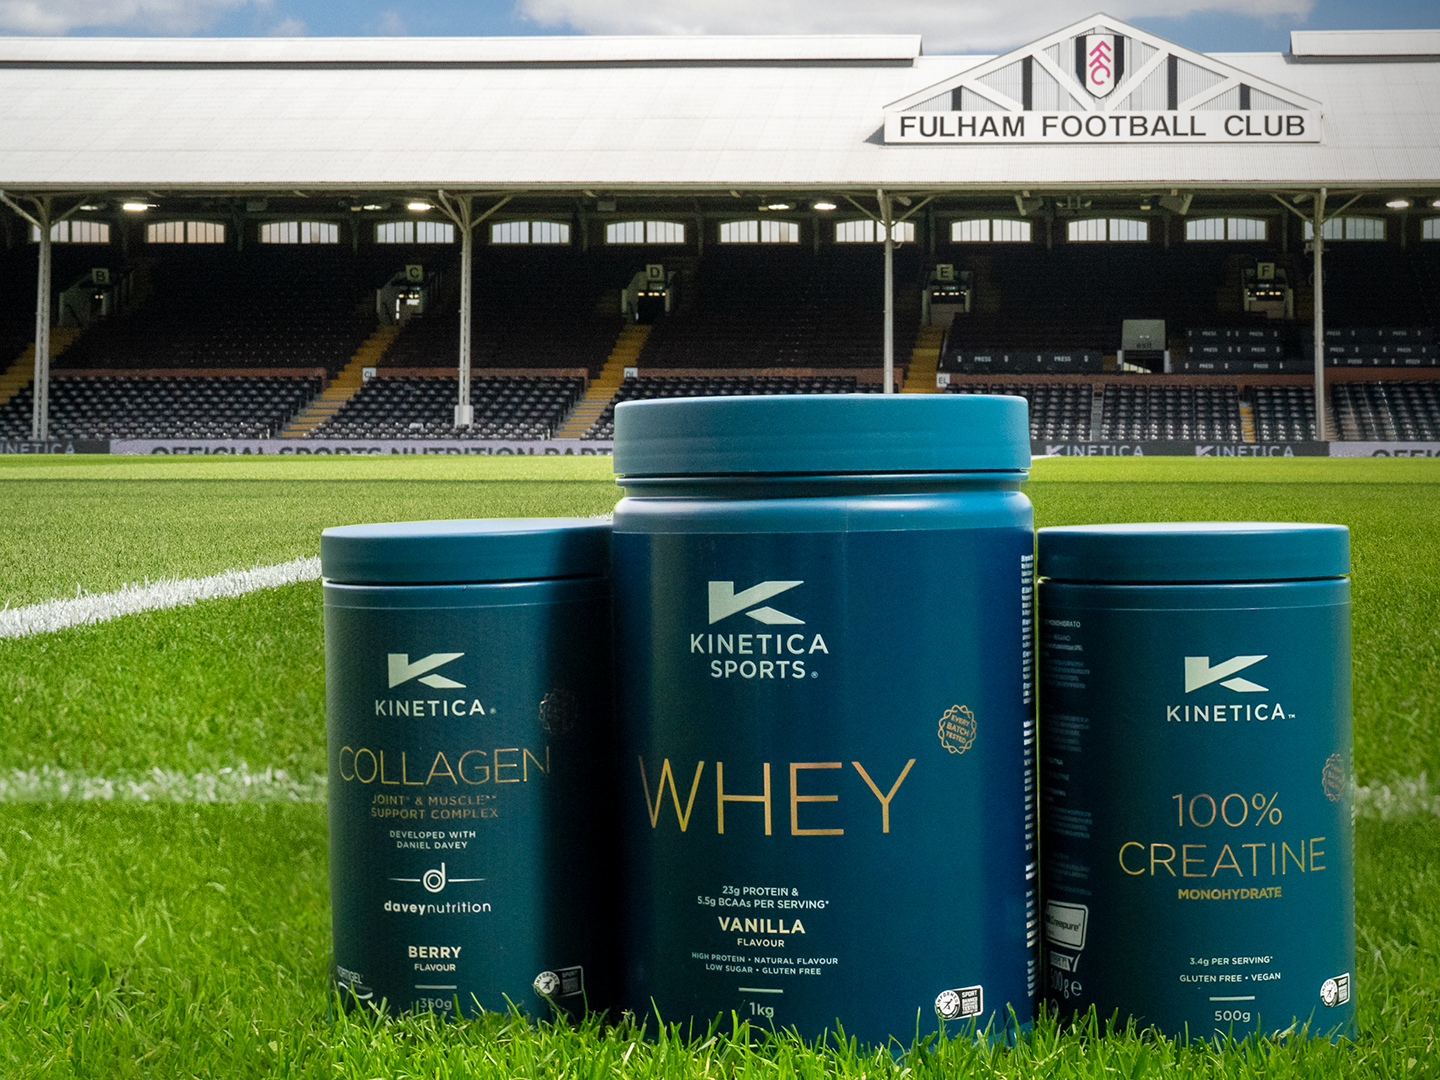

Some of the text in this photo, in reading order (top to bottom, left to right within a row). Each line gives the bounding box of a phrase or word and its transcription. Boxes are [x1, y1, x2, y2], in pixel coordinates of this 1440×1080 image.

[900, 114, 1305, 137] FULHAM FOOTBALL CLUB
[690, 633, 829, 655] KINETICA
[950, 714, 970, 727] EVERY
[946, 721, 970, 737] BATCH
[945, 731, 967, 744] TESTED
[339, 746, 550, 786] COLLAGEN
[639, 755, 916, 836] WHEY
[371, 807, 499, 819] SUPPORT COMPLEX
[1172, 791, 1282, 828] 100%
[389, 830, 476, 839] DEVELOPED WITH
[396, 841, 468, 849] DANIEL DAVEY
[1119, 837, 1326, 878] CREATINE
[722, 886, 799, 897] 23g PROTEIN &
[1178, 886, 1282, 900] MONOHYDRATE
[384, 900, 492, 915] daveynutrition
[697, 895, 716, 908] 5.5g
[718, 897, 751, 908] BCAAs
[754, 899, 775, 909] PER
[718, 916, 806, 934] VANILLA
[737, 938, 785, 947] FLAVOUR
[408, 945, 461, 959] BERRY
[691, 951, 838, 965] HIGH PROTEIN NATURAL FLAVOUR
[414, 963, 456, 972] FLAVOUR
[705, 963, 723, 972] LOW
[725, 964, 753, 973] SUGAR
[762, 967, 796, 975] GLUTEN
[1189, 957, 1210, 967] 3.4g
[1211, 957, 1230, 965] PER
[1179, 972, 1281, 983] GLUTEN FREE VEGAN
[420, 998, 453, 1011] 350g
[749, 1002, 775, 1018] 1kg
[1214, 1010, 1251, 1022] 500g
